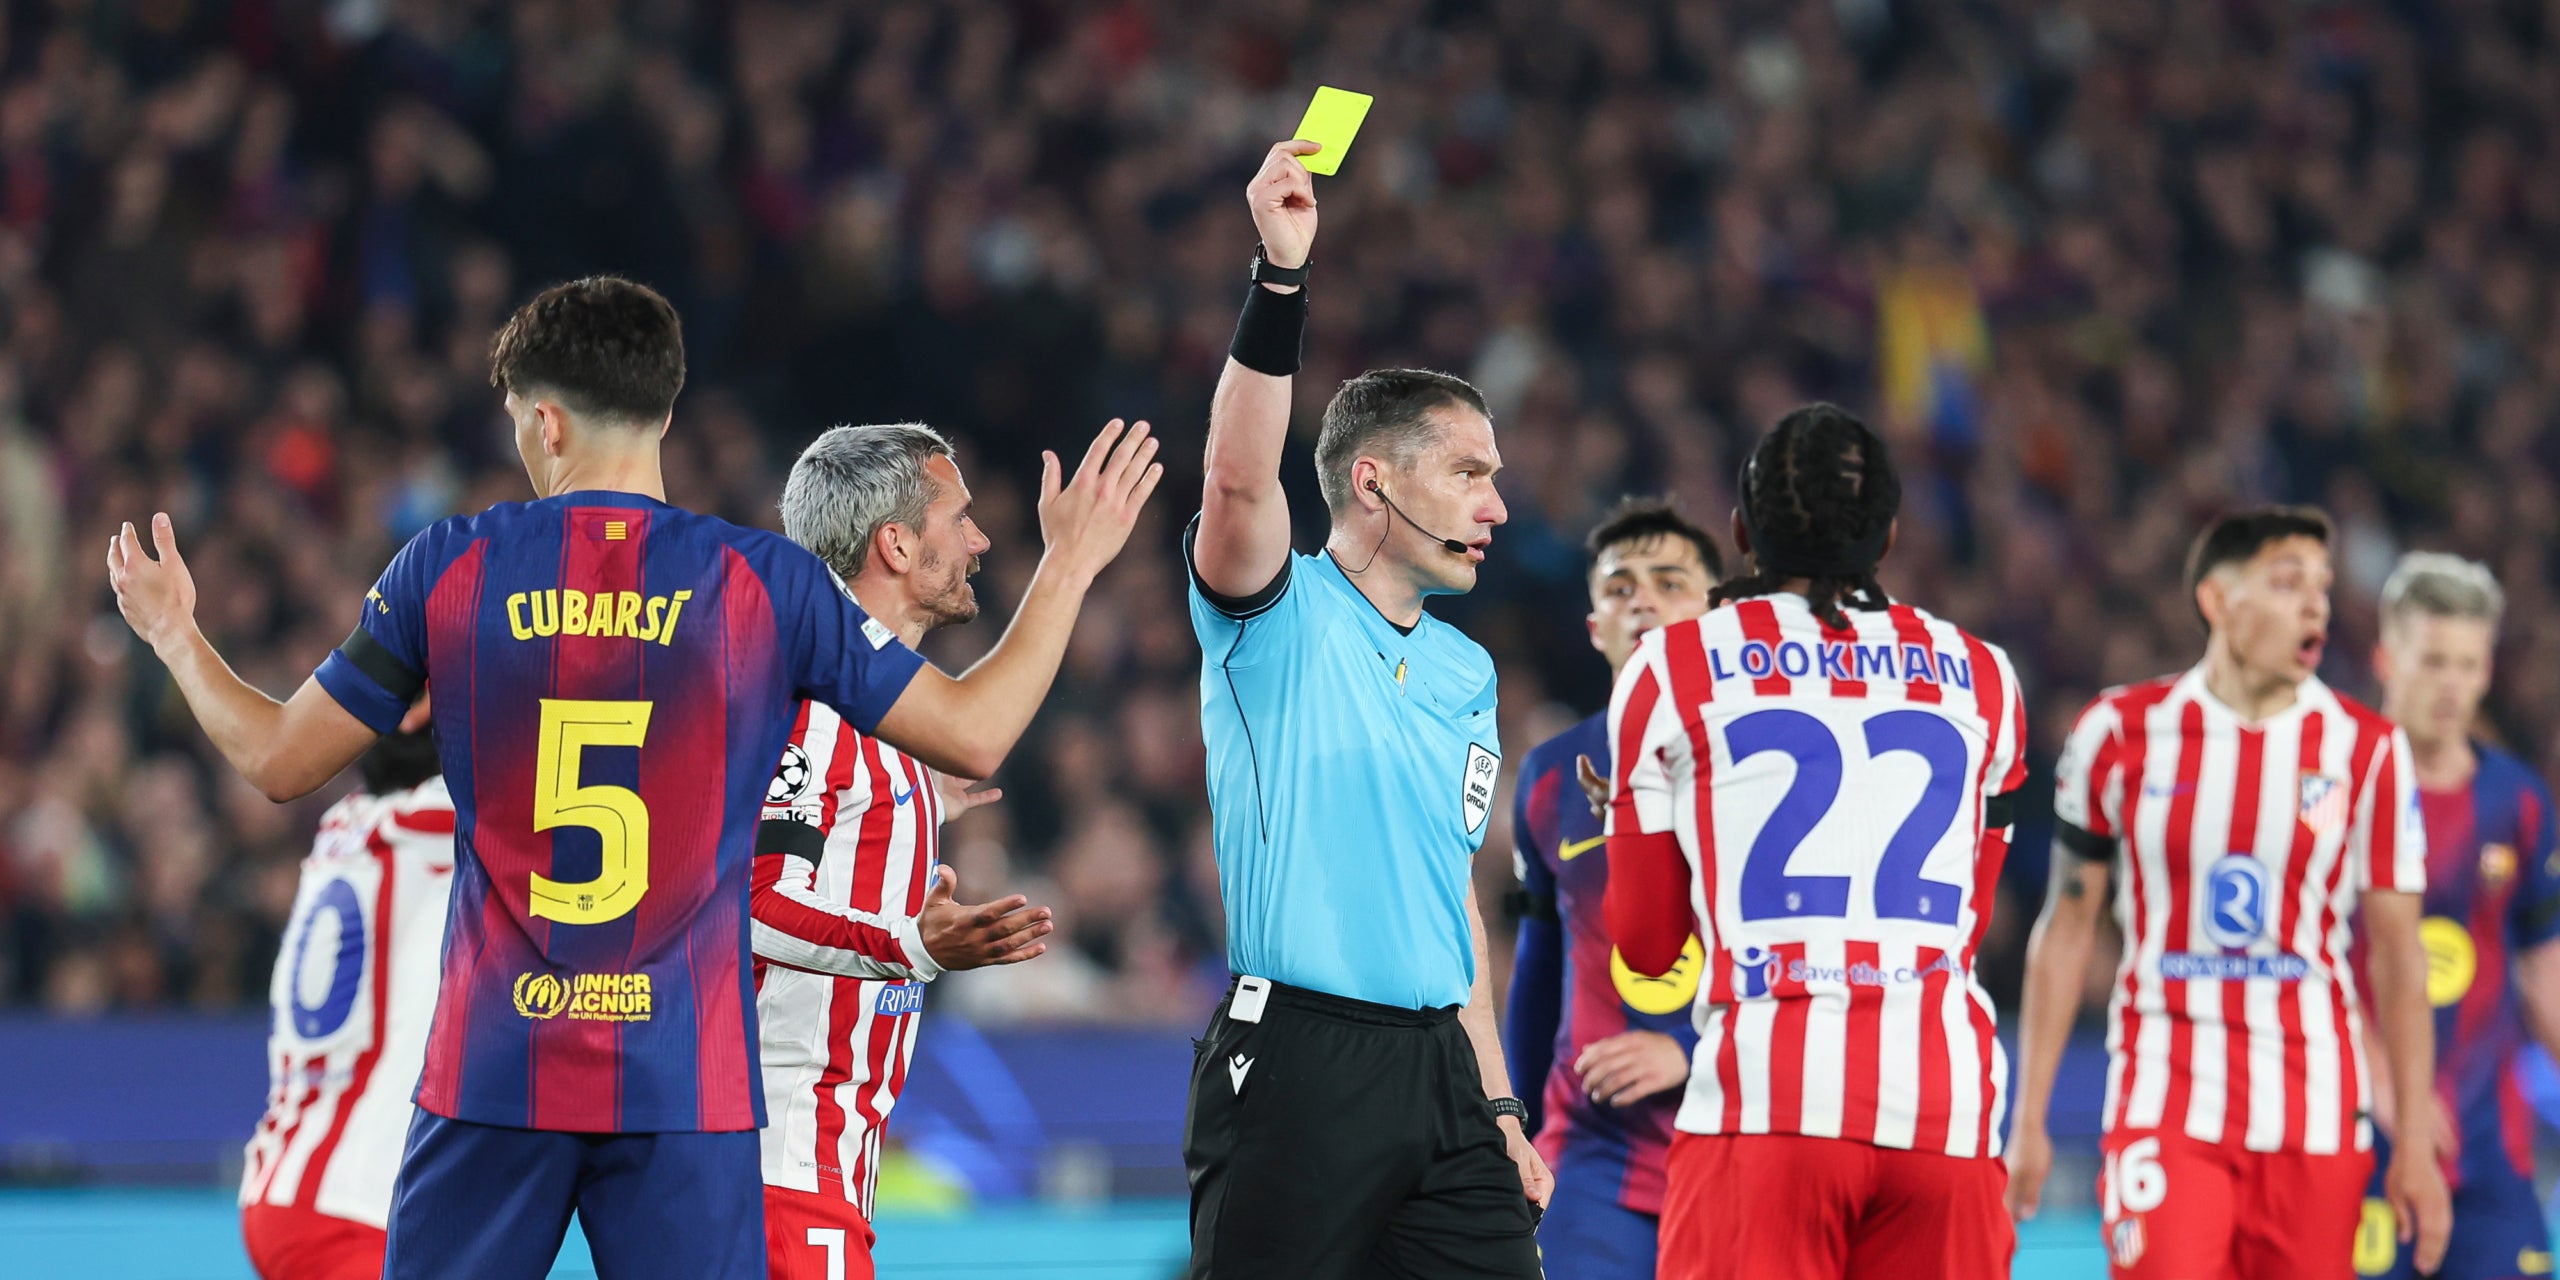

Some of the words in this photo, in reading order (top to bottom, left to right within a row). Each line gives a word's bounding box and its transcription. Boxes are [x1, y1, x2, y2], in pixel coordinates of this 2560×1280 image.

[506, 588, 693, 647] CUBARSÍ
[1709, 641, 1972, 691] LOOKMAN
[1474, 758, 1492, 779] UEFA
[1470, 781, 1488, 798] MATCH
[528, 698, 654, 925] 5
[1466, 793, 1486, 812] OFFICIAL
[1723, 708, 1969, 928] 22
[573, 973, 652, 993] UNHCR
[1787, 957, 1843, 983] Save
[1850, 961, 1888, 986] the
[568, 993, 652, 1013] ACNUR
[568, 1012, 579, 1020] The
[581, 1012, 592, 1020] UN
[593, 1013, 624, 1022] Refugee
[624, 1013, 651, 1023] Agency
[2103, 1135, 2168, 1224] 16
